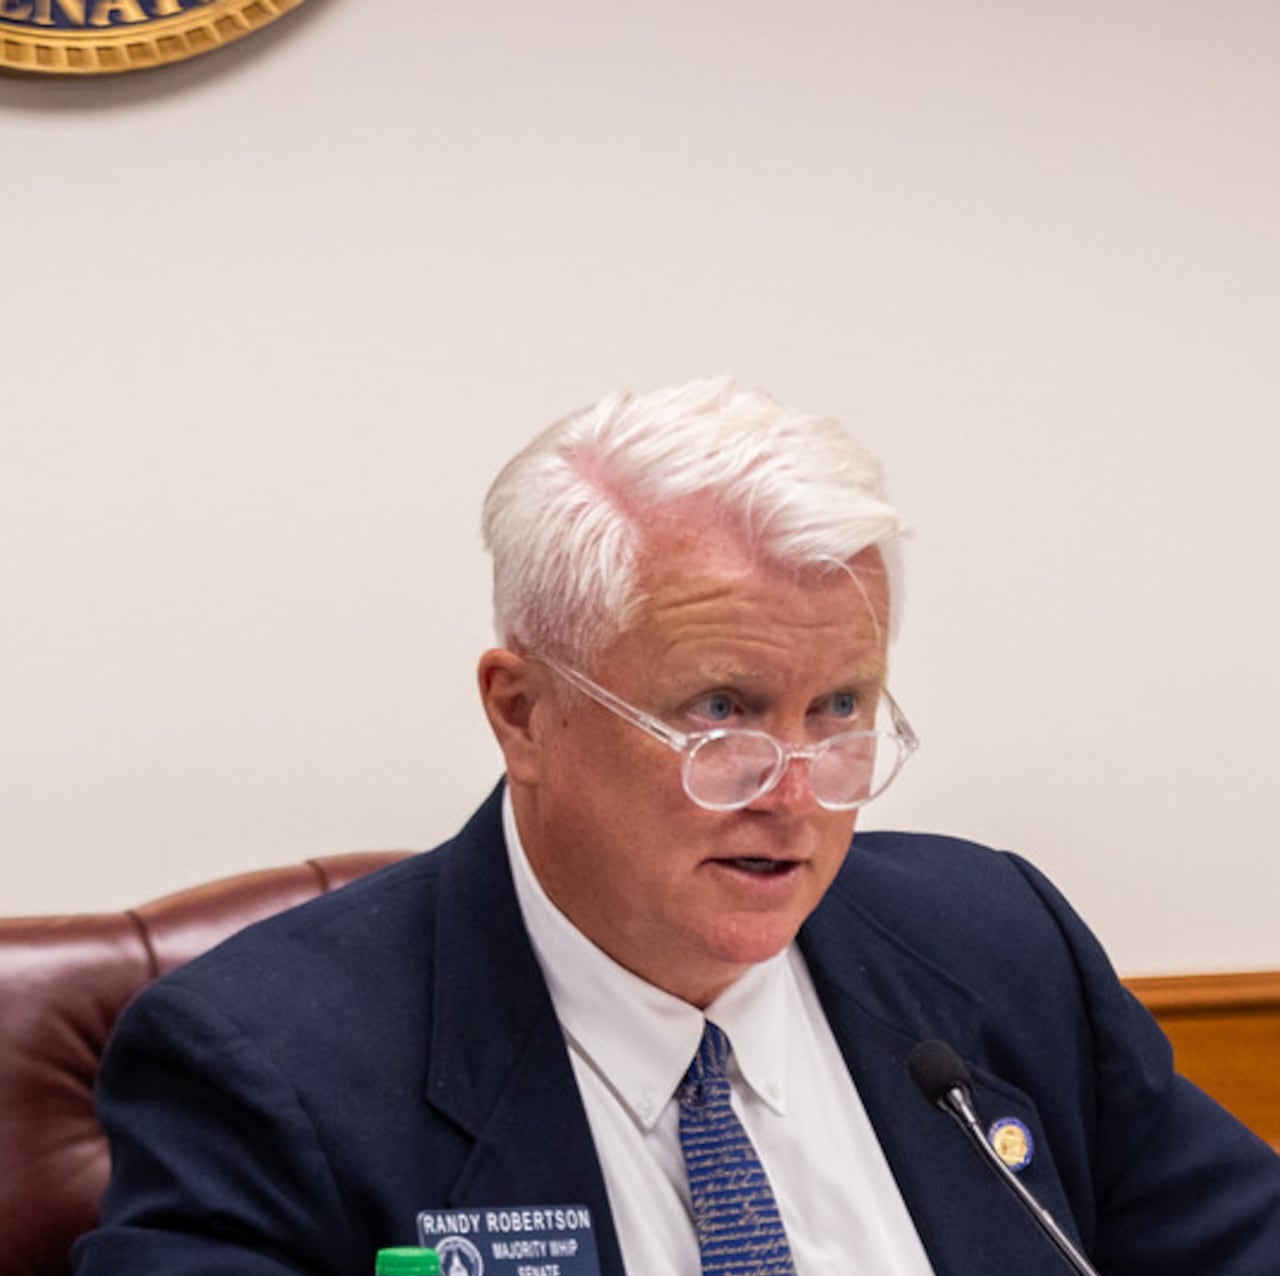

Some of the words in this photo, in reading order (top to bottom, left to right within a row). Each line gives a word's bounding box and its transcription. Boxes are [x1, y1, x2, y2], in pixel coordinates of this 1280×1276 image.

[423, 1213, 480, 1234] RANDY
[486, 1209, 591, 1232] ROBERTSON
[492, 1241, 547, 1259] MAJORITY
[549, 1239, 578, 1257] WHIP
